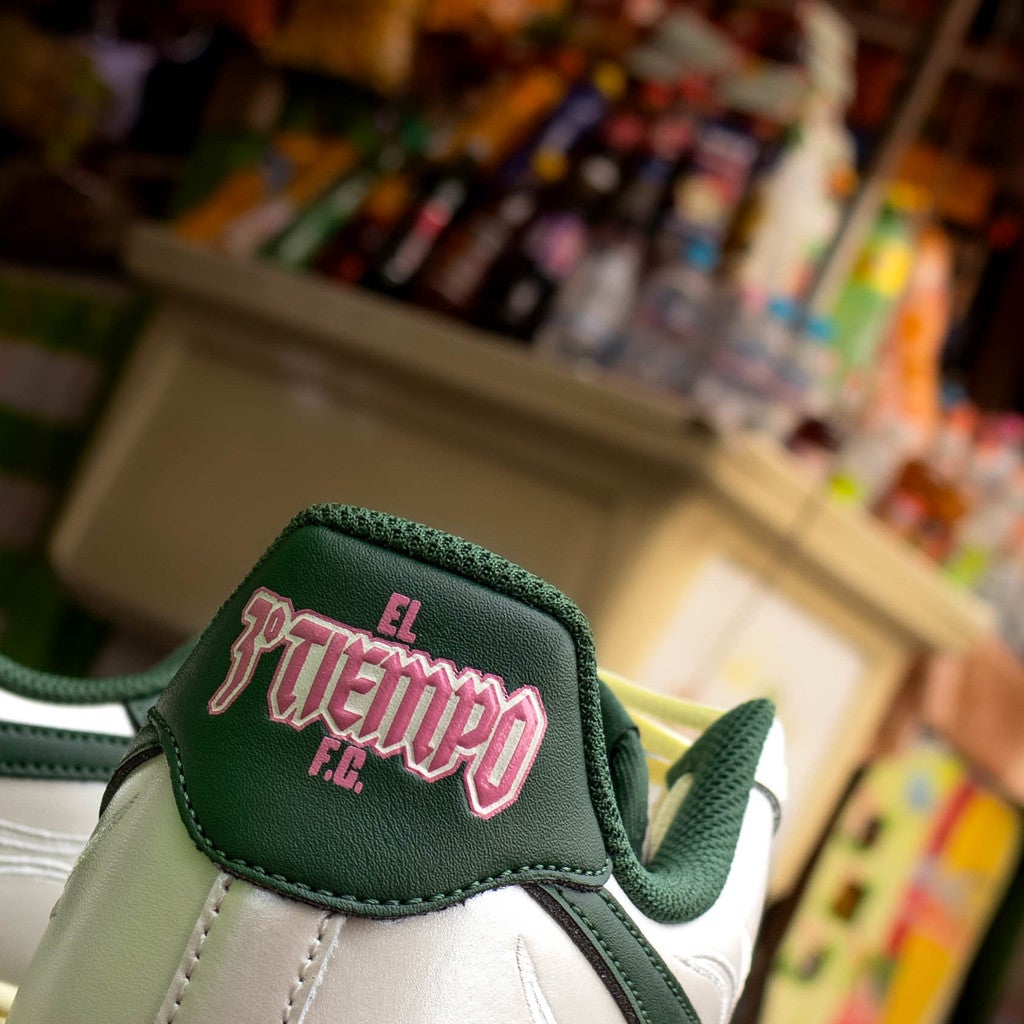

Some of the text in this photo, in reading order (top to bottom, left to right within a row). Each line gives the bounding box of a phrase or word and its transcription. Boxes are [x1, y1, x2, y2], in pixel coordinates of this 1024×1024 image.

[377, 593, 422, 642] EL
[269, 609, 548, 819] TIEMPO
[308, 737, 365, 795] F.C.
